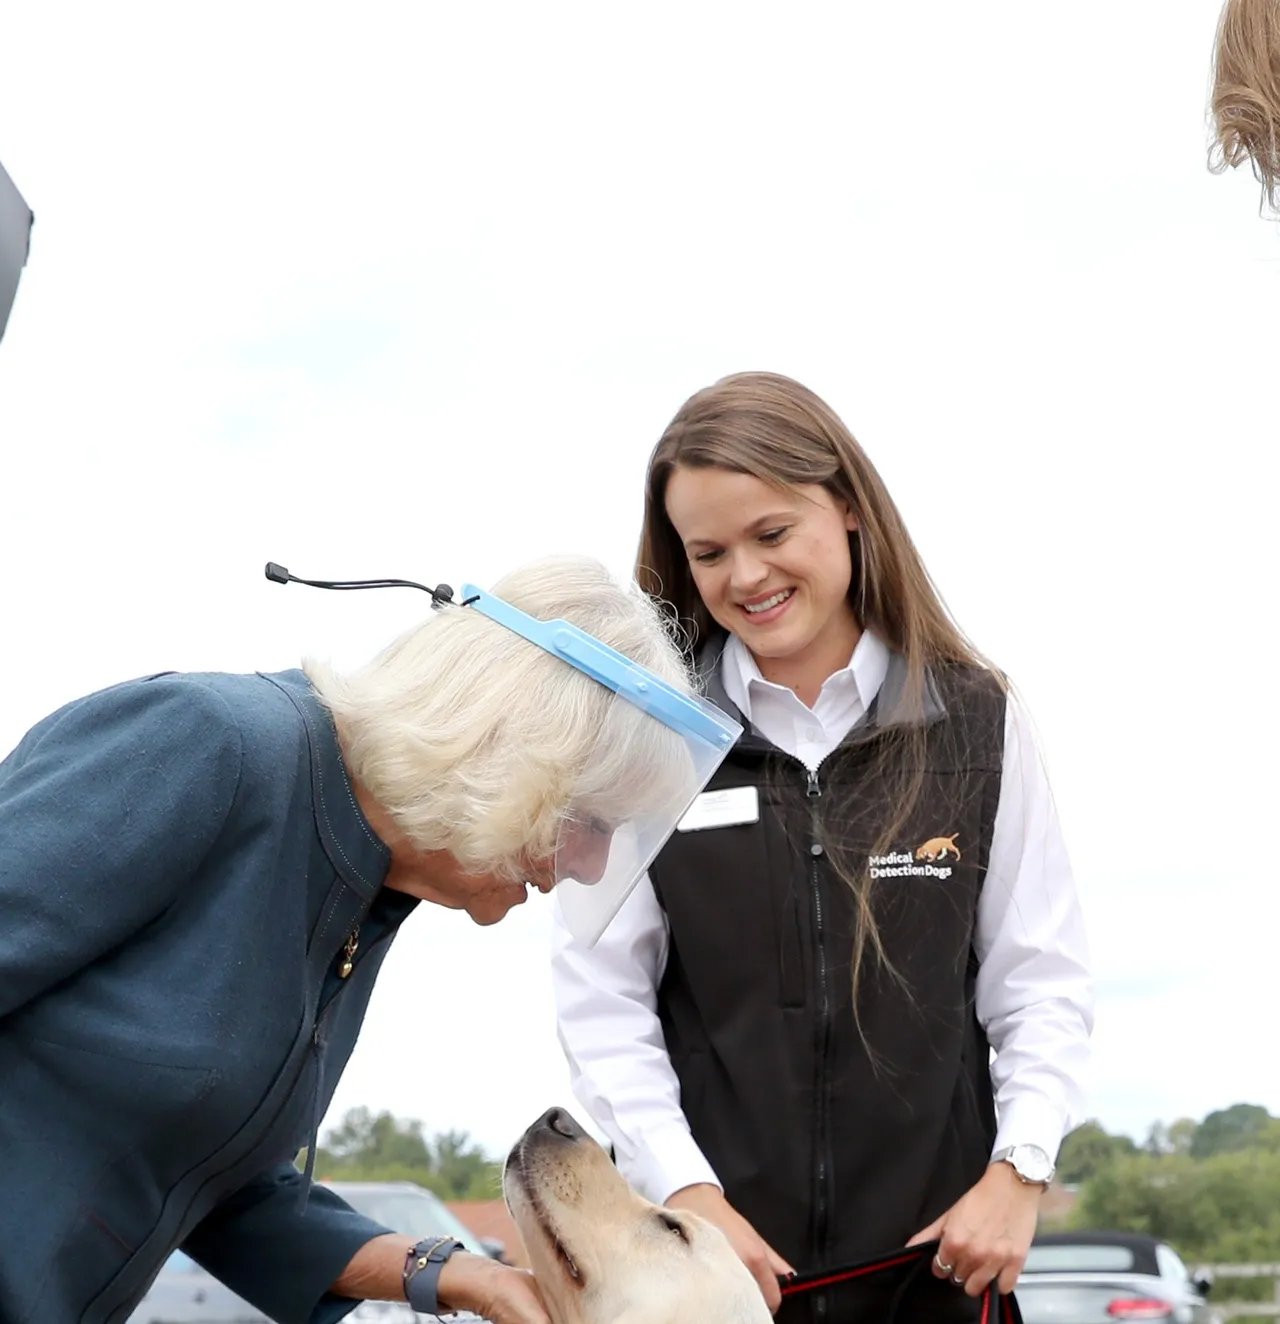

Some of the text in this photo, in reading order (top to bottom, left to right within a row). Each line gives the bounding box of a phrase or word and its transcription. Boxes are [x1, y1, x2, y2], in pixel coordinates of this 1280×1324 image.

[868, 851, 914, 867] Medical
[870, 864, 952, 880] Detection Dogs
